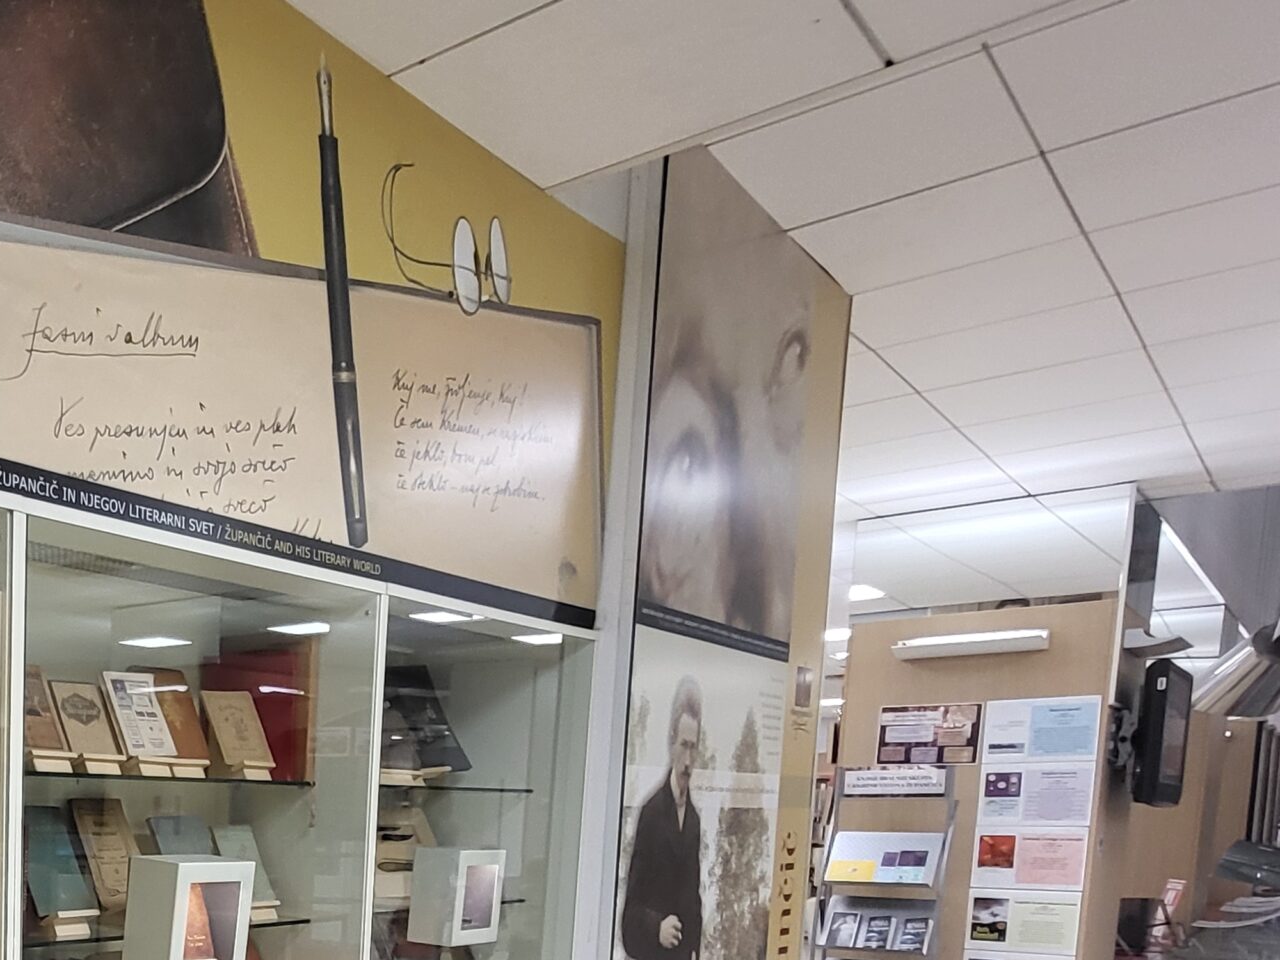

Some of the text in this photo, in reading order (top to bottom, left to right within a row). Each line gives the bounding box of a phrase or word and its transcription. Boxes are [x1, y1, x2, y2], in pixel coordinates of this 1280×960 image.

[62, 486, 77, 503] IN
[80, 491, 126, 515] NJEGOV
[129, 505, 185, 529] LITERARNI
[189, 518, 215, 536] SVET
[225, 524, 272, 550] ŽUPANČIČ
[274, 542, 293, 555] AND
[295, 546, 311, 559] HIS
[313, 549, 352, 568] LITERARY
[353, 559, 381, 575] WORLD
